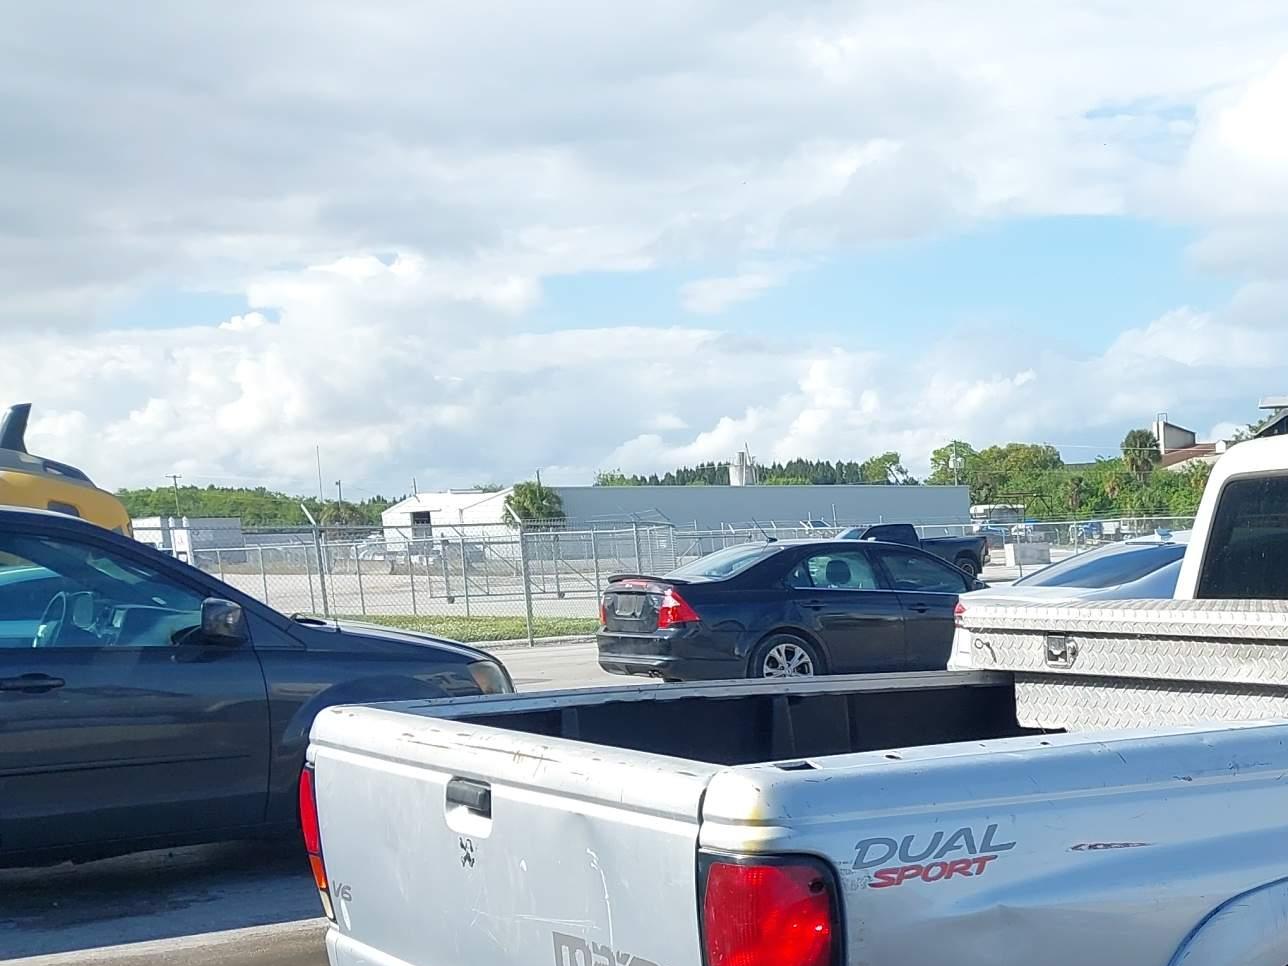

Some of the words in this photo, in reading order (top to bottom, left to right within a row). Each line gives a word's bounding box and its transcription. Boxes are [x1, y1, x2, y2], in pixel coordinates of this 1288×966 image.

[852, 823, 1017, 870] DUAL
[868, 854, 998, 889] SPORT
[332, 879, 353, 902] V6
